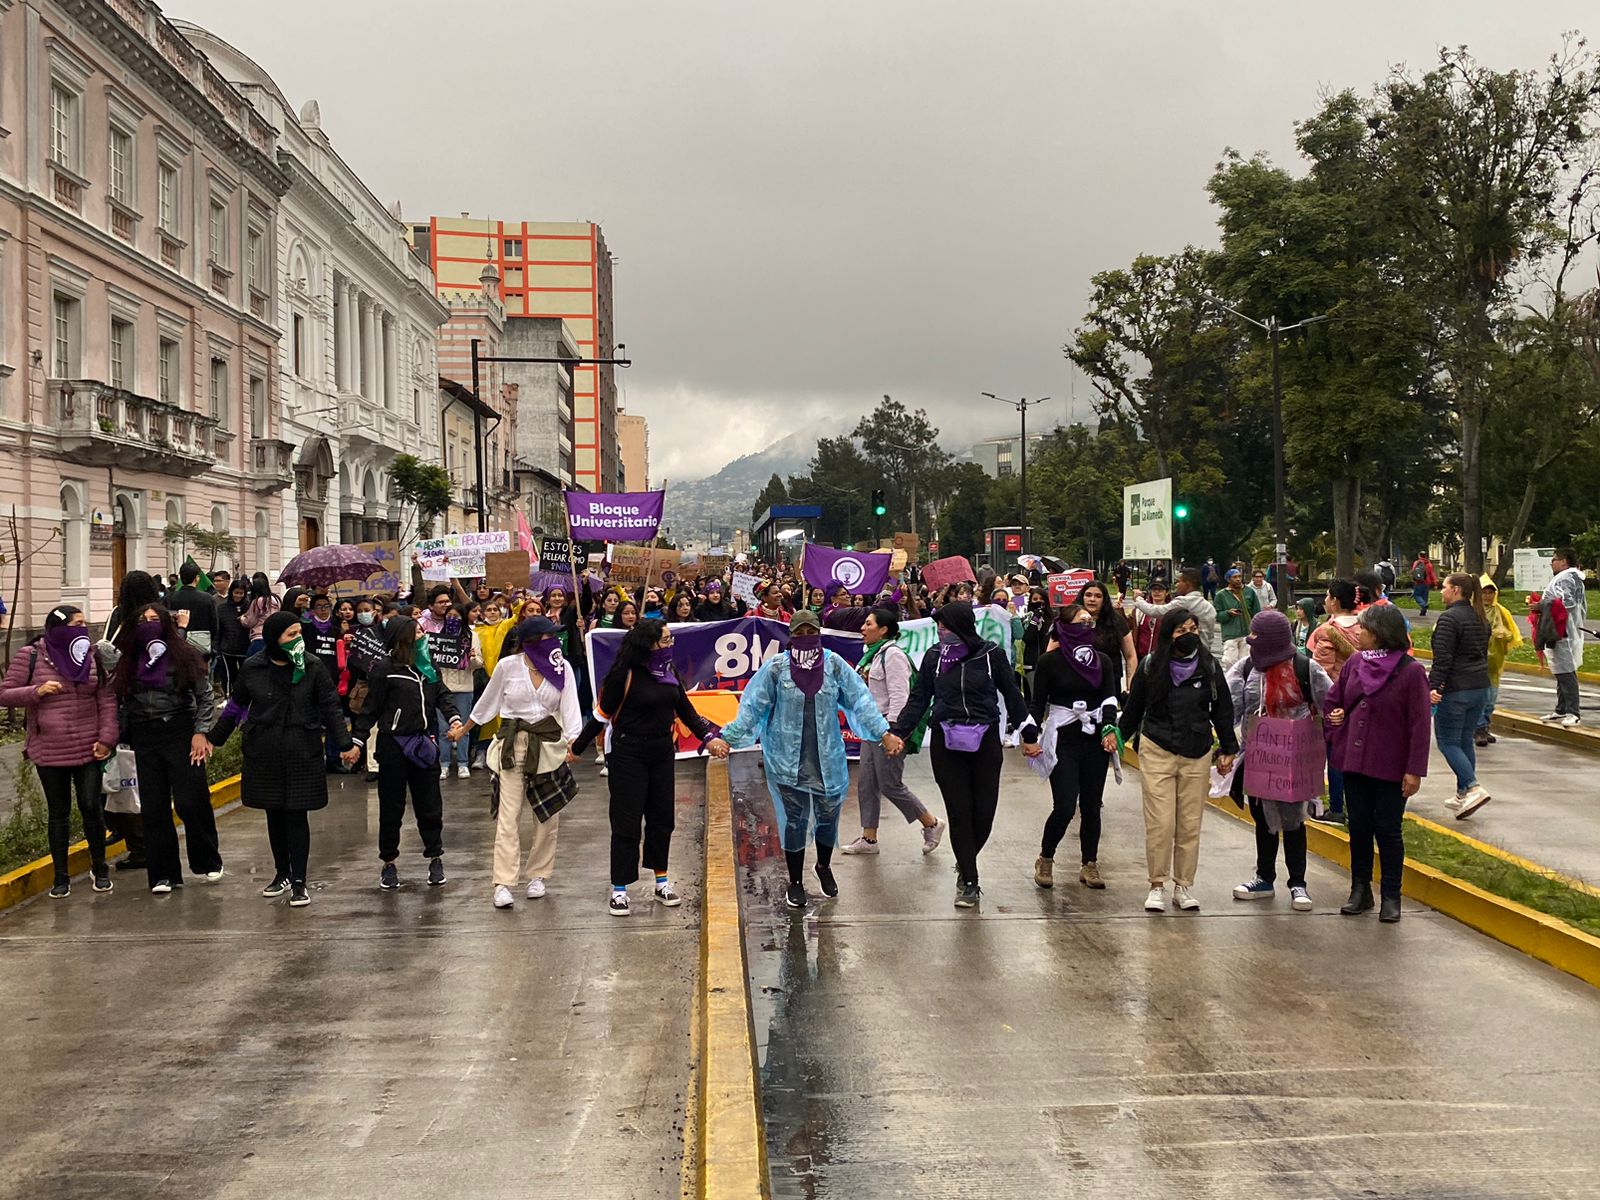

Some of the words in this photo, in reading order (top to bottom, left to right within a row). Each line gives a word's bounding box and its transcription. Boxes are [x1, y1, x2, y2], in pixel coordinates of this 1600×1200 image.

[1142, 497, 1156, 507] Parque
[589, 502, 640, 519] Bloque
[1147, 508, 1163, 520] Alameda
[570, 514, 658, 528] Universitario
[462, 533, 507, 546] ABUSADOR
[544, 541, 568, 552] ESTO
[572, 544, 583, 555] ES
[542, 552, 567, 567] PELEAR
[660, 559, 672, 569] ES
[432, 653, 460, 665] MIEDO
